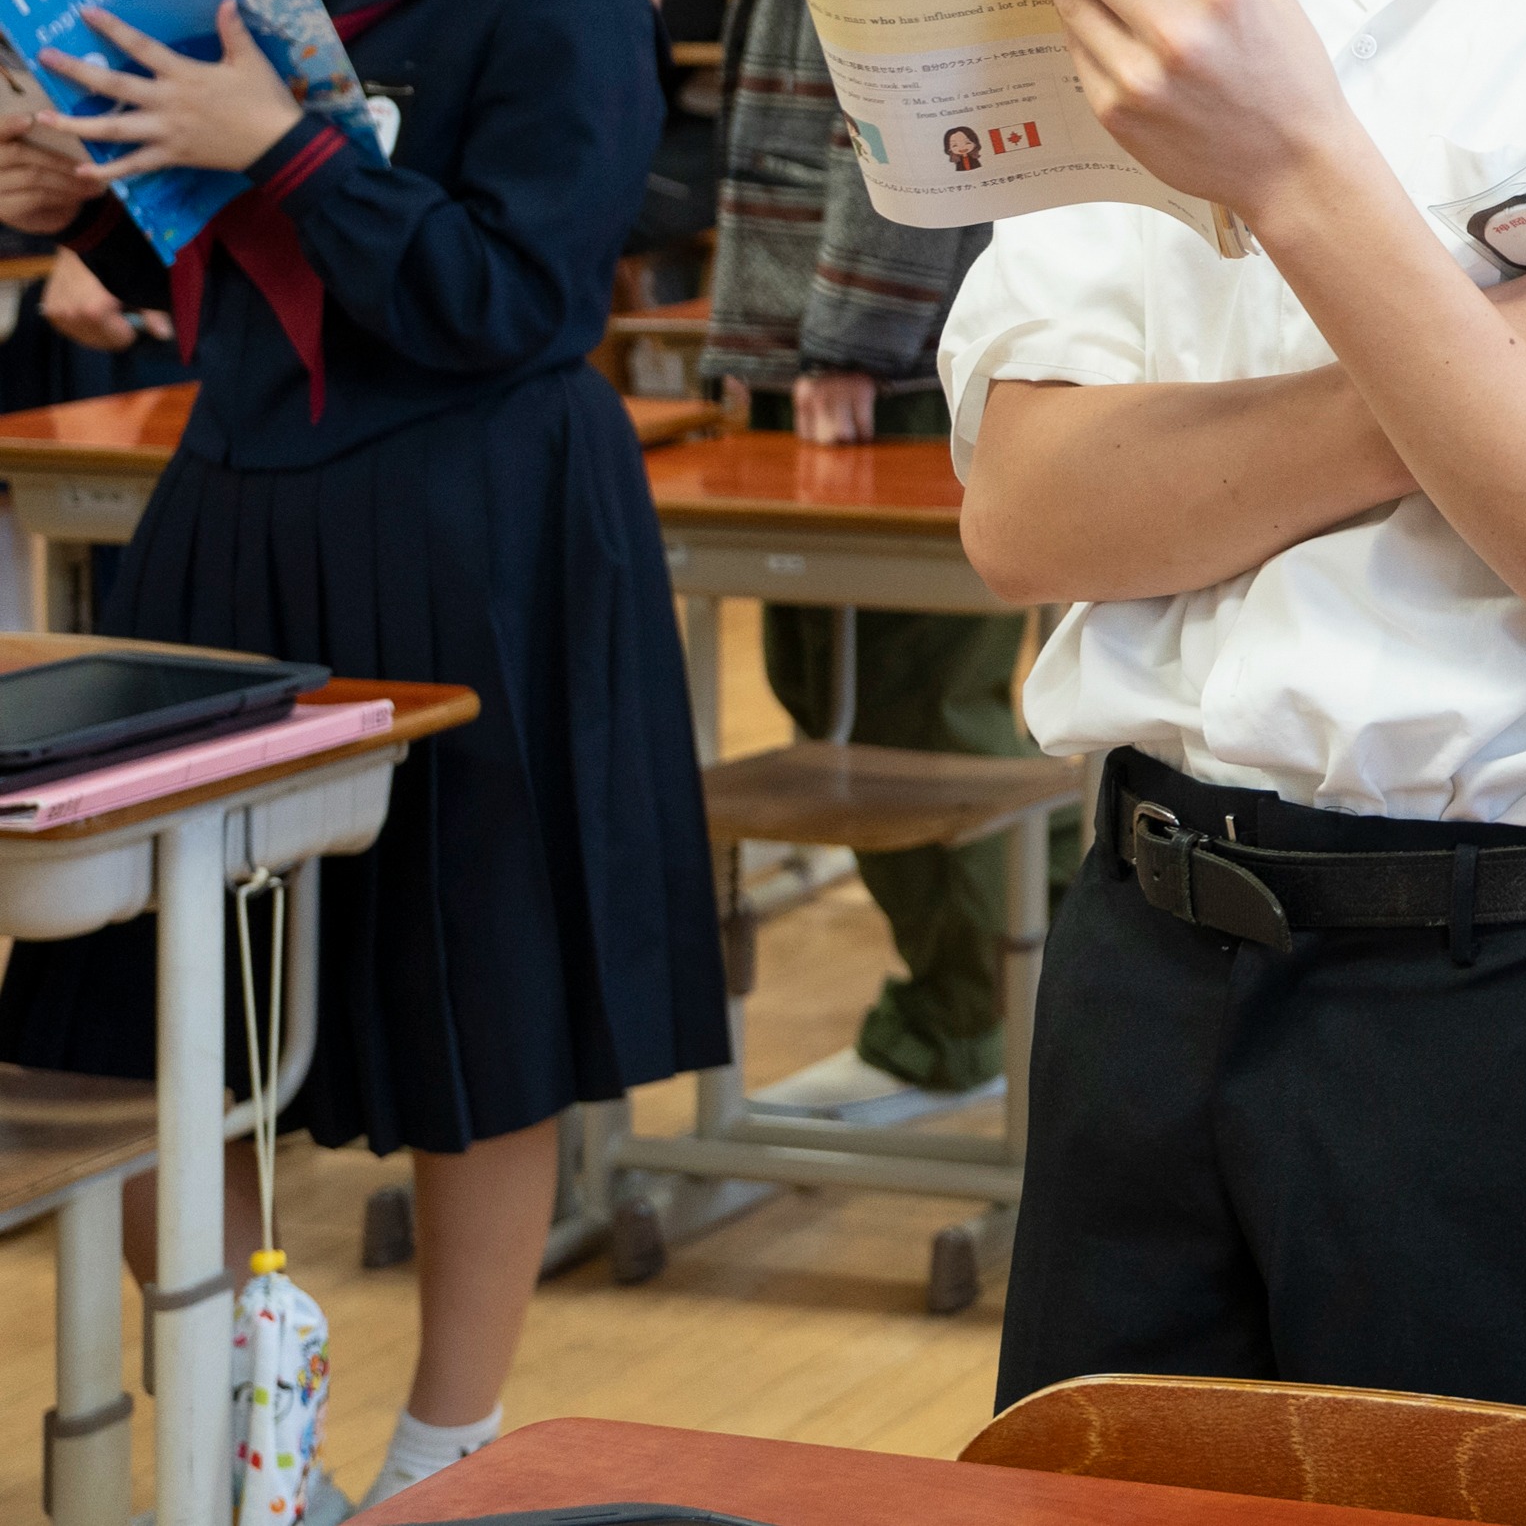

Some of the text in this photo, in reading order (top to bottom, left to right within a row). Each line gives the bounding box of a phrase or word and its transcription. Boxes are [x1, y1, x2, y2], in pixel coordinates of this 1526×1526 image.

[844, 15, 866, 24] man
[870, 15, 896, 25] who
[899, 15, 920, 25] has
[923, 5, 984, 23] influenced
[998, 0, 1015, 11] lot
[931, 94, 954, 105] Chen
[972, 85, 1004, 98] teacher
[1012, 80, 1036, 90] came
[916, 94, 1038, 121] from Canada two years ago
